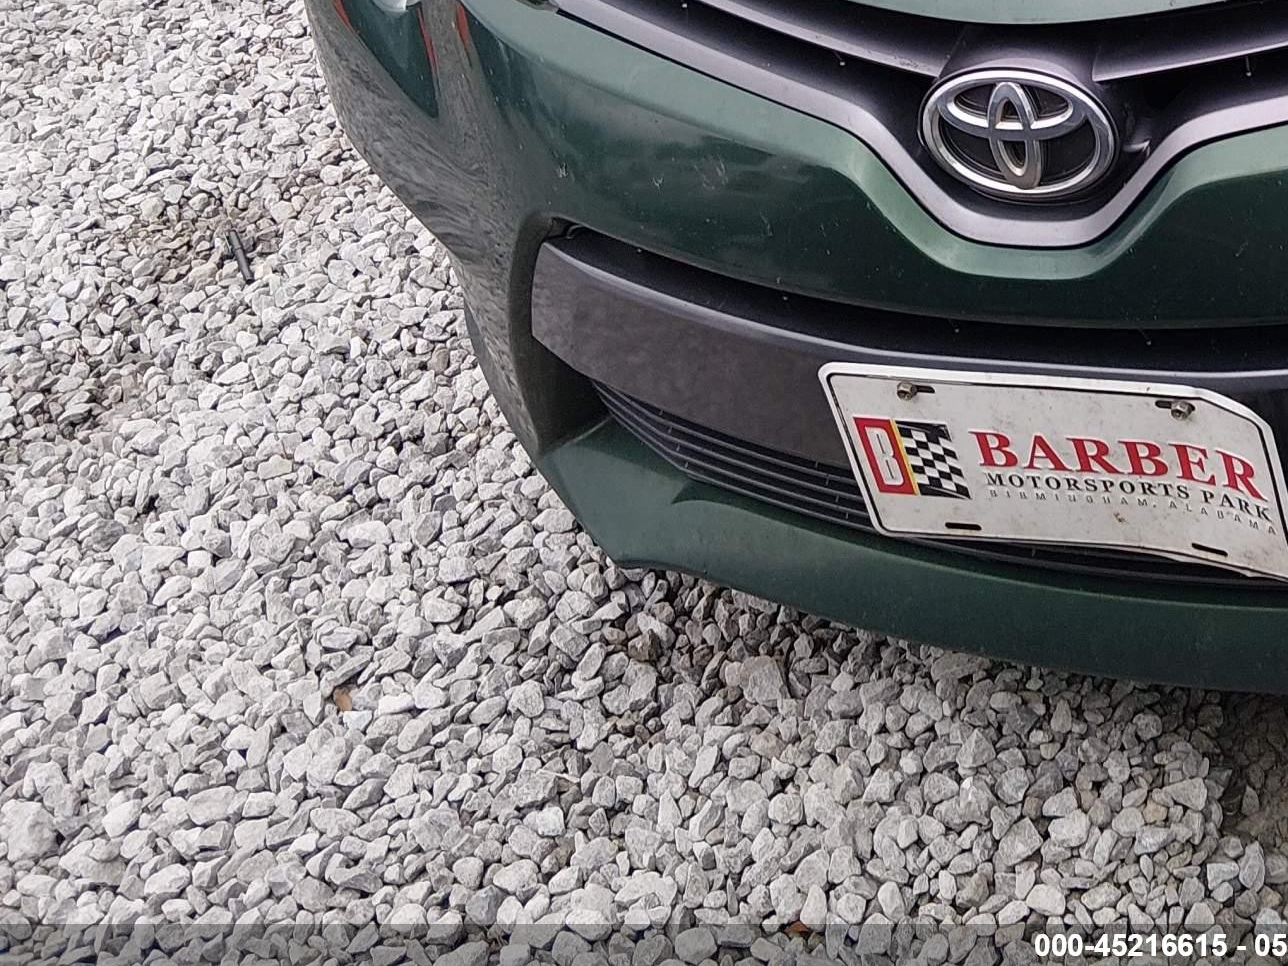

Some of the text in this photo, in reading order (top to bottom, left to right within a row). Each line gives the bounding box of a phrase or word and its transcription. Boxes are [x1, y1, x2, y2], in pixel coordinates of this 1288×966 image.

[968, 431, 1268, 502] BARBER
[985, 472, 1273, 522] MOTORSPORTS PARK
[1169, 501, 1277, 534] ALABAMA
